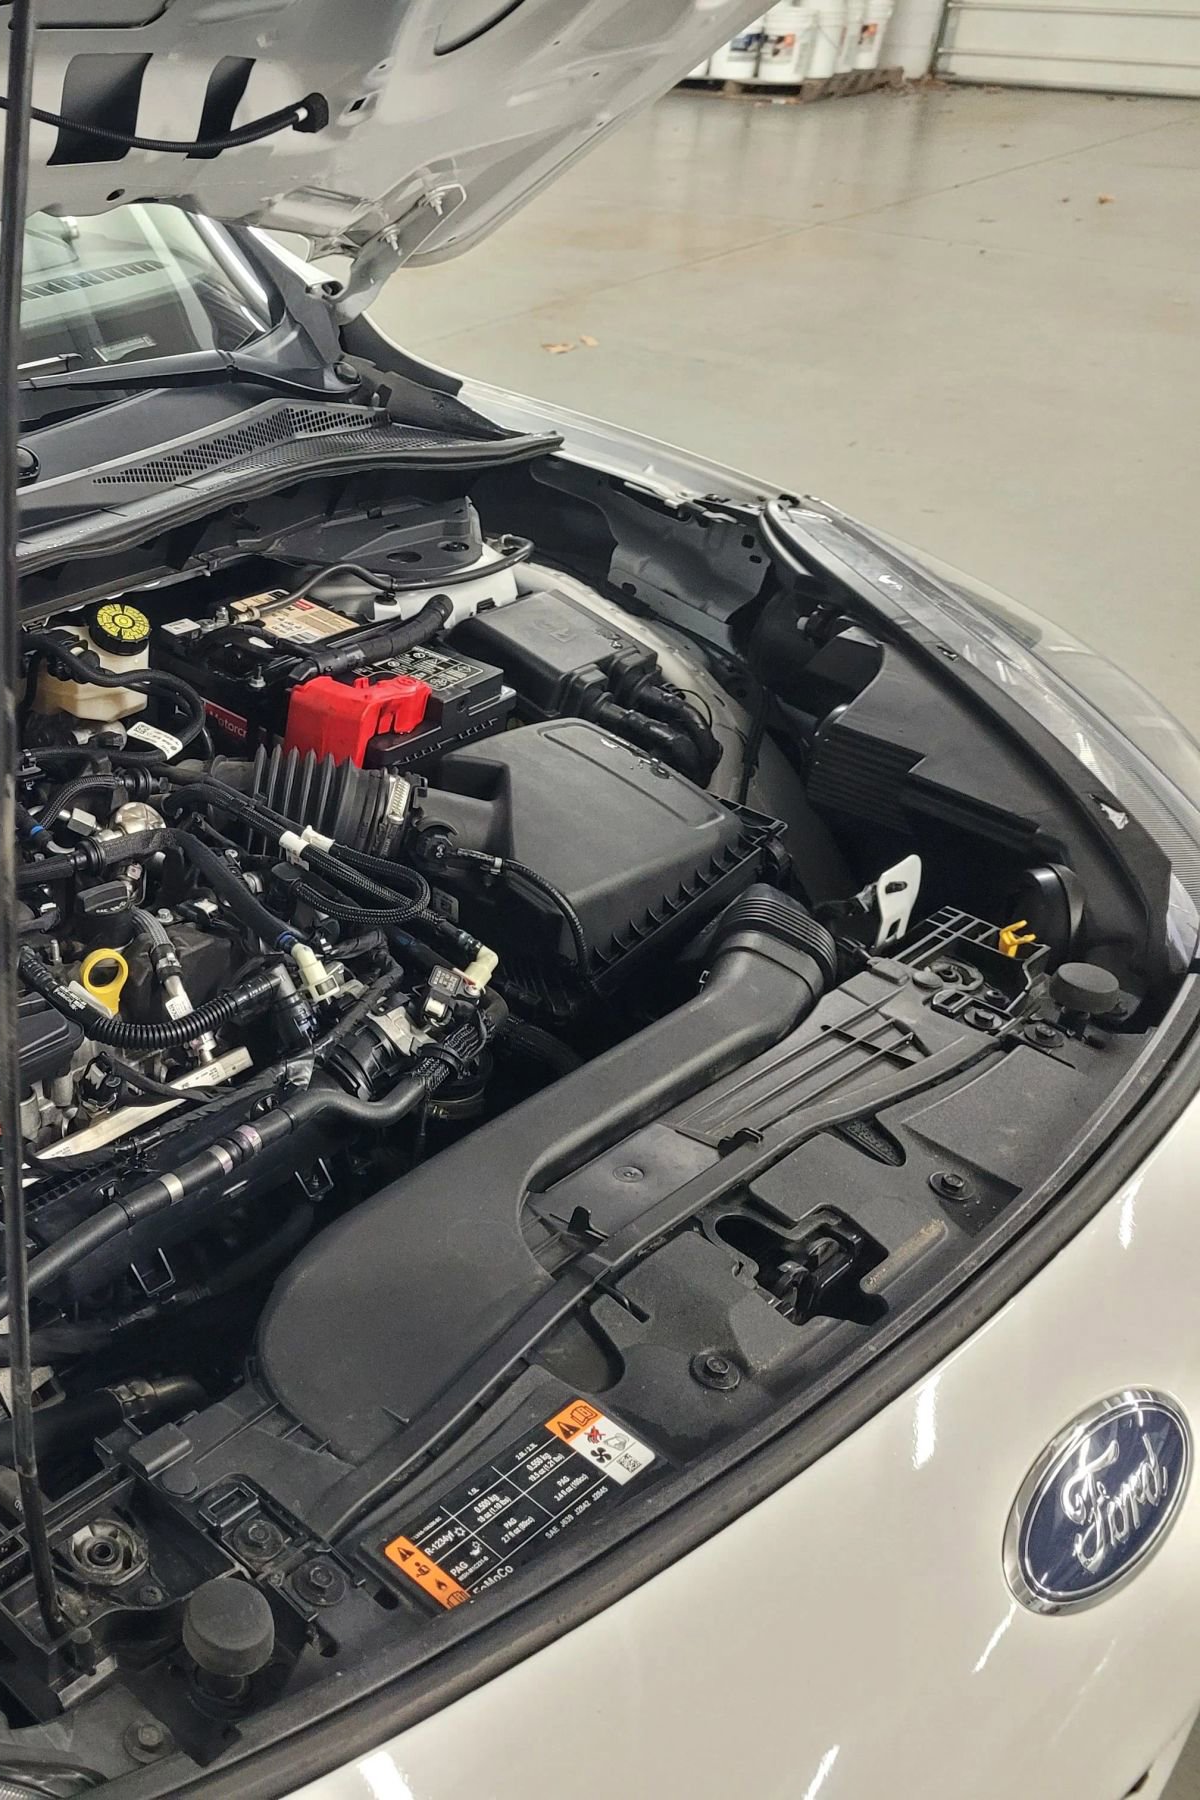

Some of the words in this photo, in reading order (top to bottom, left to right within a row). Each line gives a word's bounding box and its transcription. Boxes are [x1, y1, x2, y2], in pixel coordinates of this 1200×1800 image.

[541, 1452, 552, 1461] kg
[556, 1475, 571, 1487] PAG
[489, 1494, 500, 1503] kg
[1060, 1433, 1168, 1574] Ford
[503, 1517, 518, 1529] PAG
[544, 1526, 560, 1539] SAE
[450, 1561, 468, 1577] PAG
